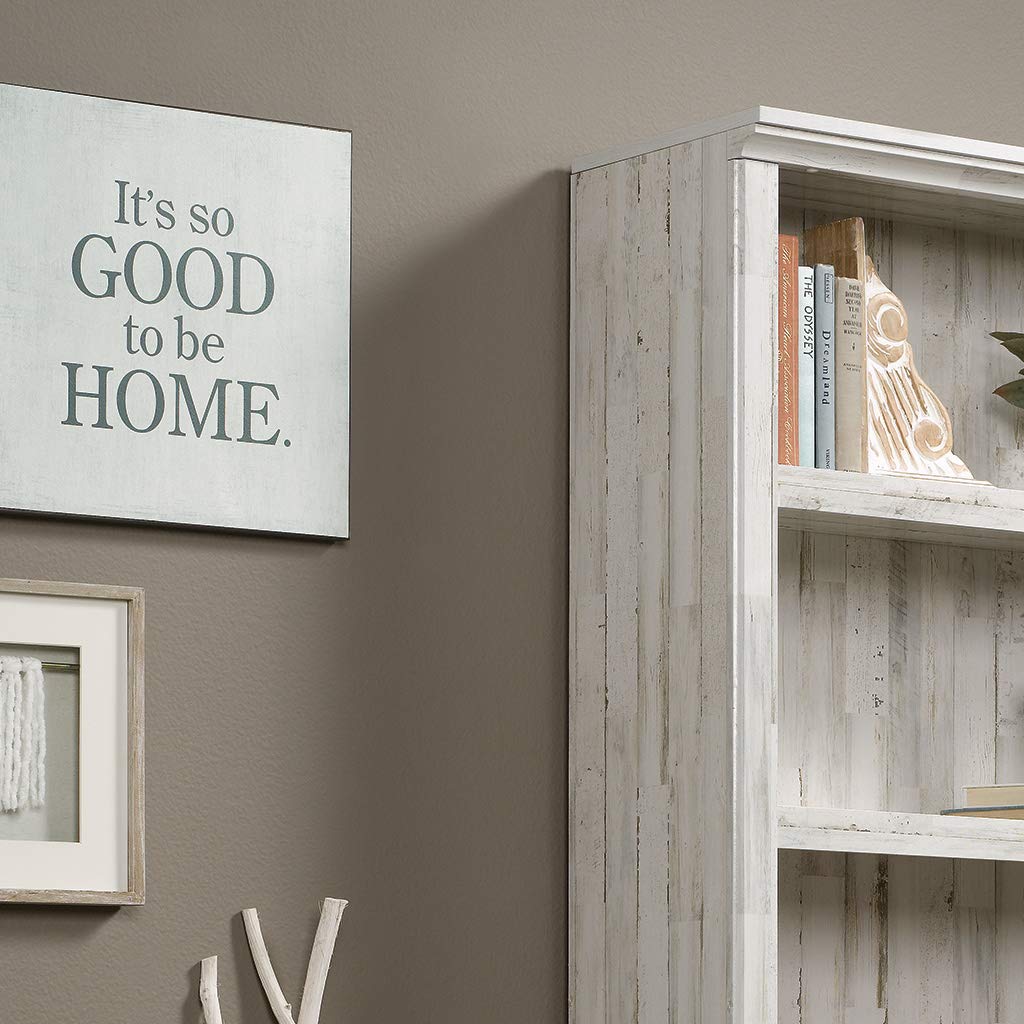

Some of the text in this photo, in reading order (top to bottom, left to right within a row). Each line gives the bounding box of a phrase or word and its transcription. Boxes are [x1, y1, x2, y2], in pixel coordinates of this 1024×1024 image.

[114, 180, 234, 236] It's so
[71, 233, 274, 316] GOOD
[782, 268, 792, 319] American
[123, 315, 224, 363] to be
[782, 321, 793, 358] Heart
[803, 275, 813, 359] THE ODYSSEY
[783, 358, 793, 413] Association
[821, 330, 831, 405] Dreamland
[61, 361, 291, 447] HOME.
